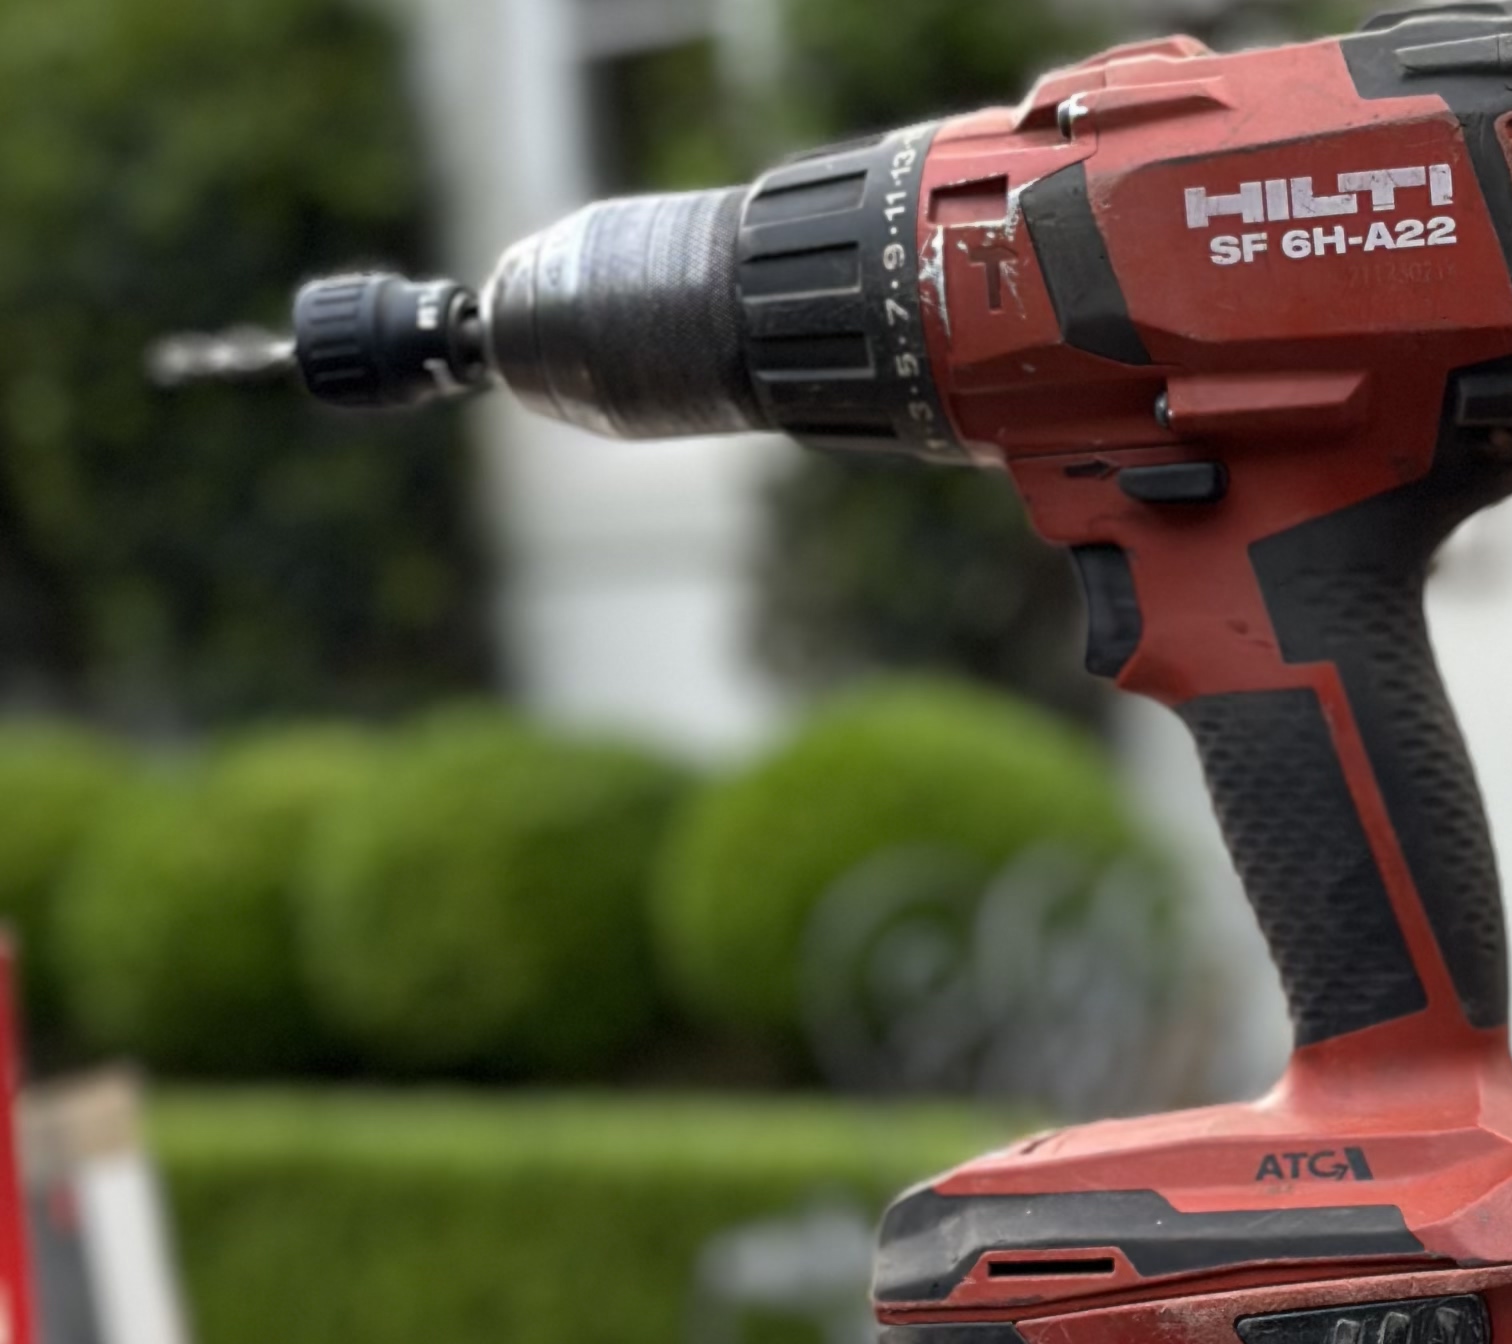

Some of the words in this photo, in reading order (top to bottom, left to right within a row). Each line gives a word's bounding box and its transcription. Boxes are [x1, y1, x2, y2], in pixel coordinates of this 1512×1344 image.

[890, 148, 917, 180] 13
[884, 191, 907, 222] 11
[1184, 163, 1454, 229] HILTI
[1209, 232, 1268, 266] SF
[1281, 216, 1458, 259] 6H-A22
[883, 243, 906, 271] 9
[885, 298, 909, 326] 7
[895, 353, 919, 377] 5
[1255, 1149, 1349, 1181] ATC
